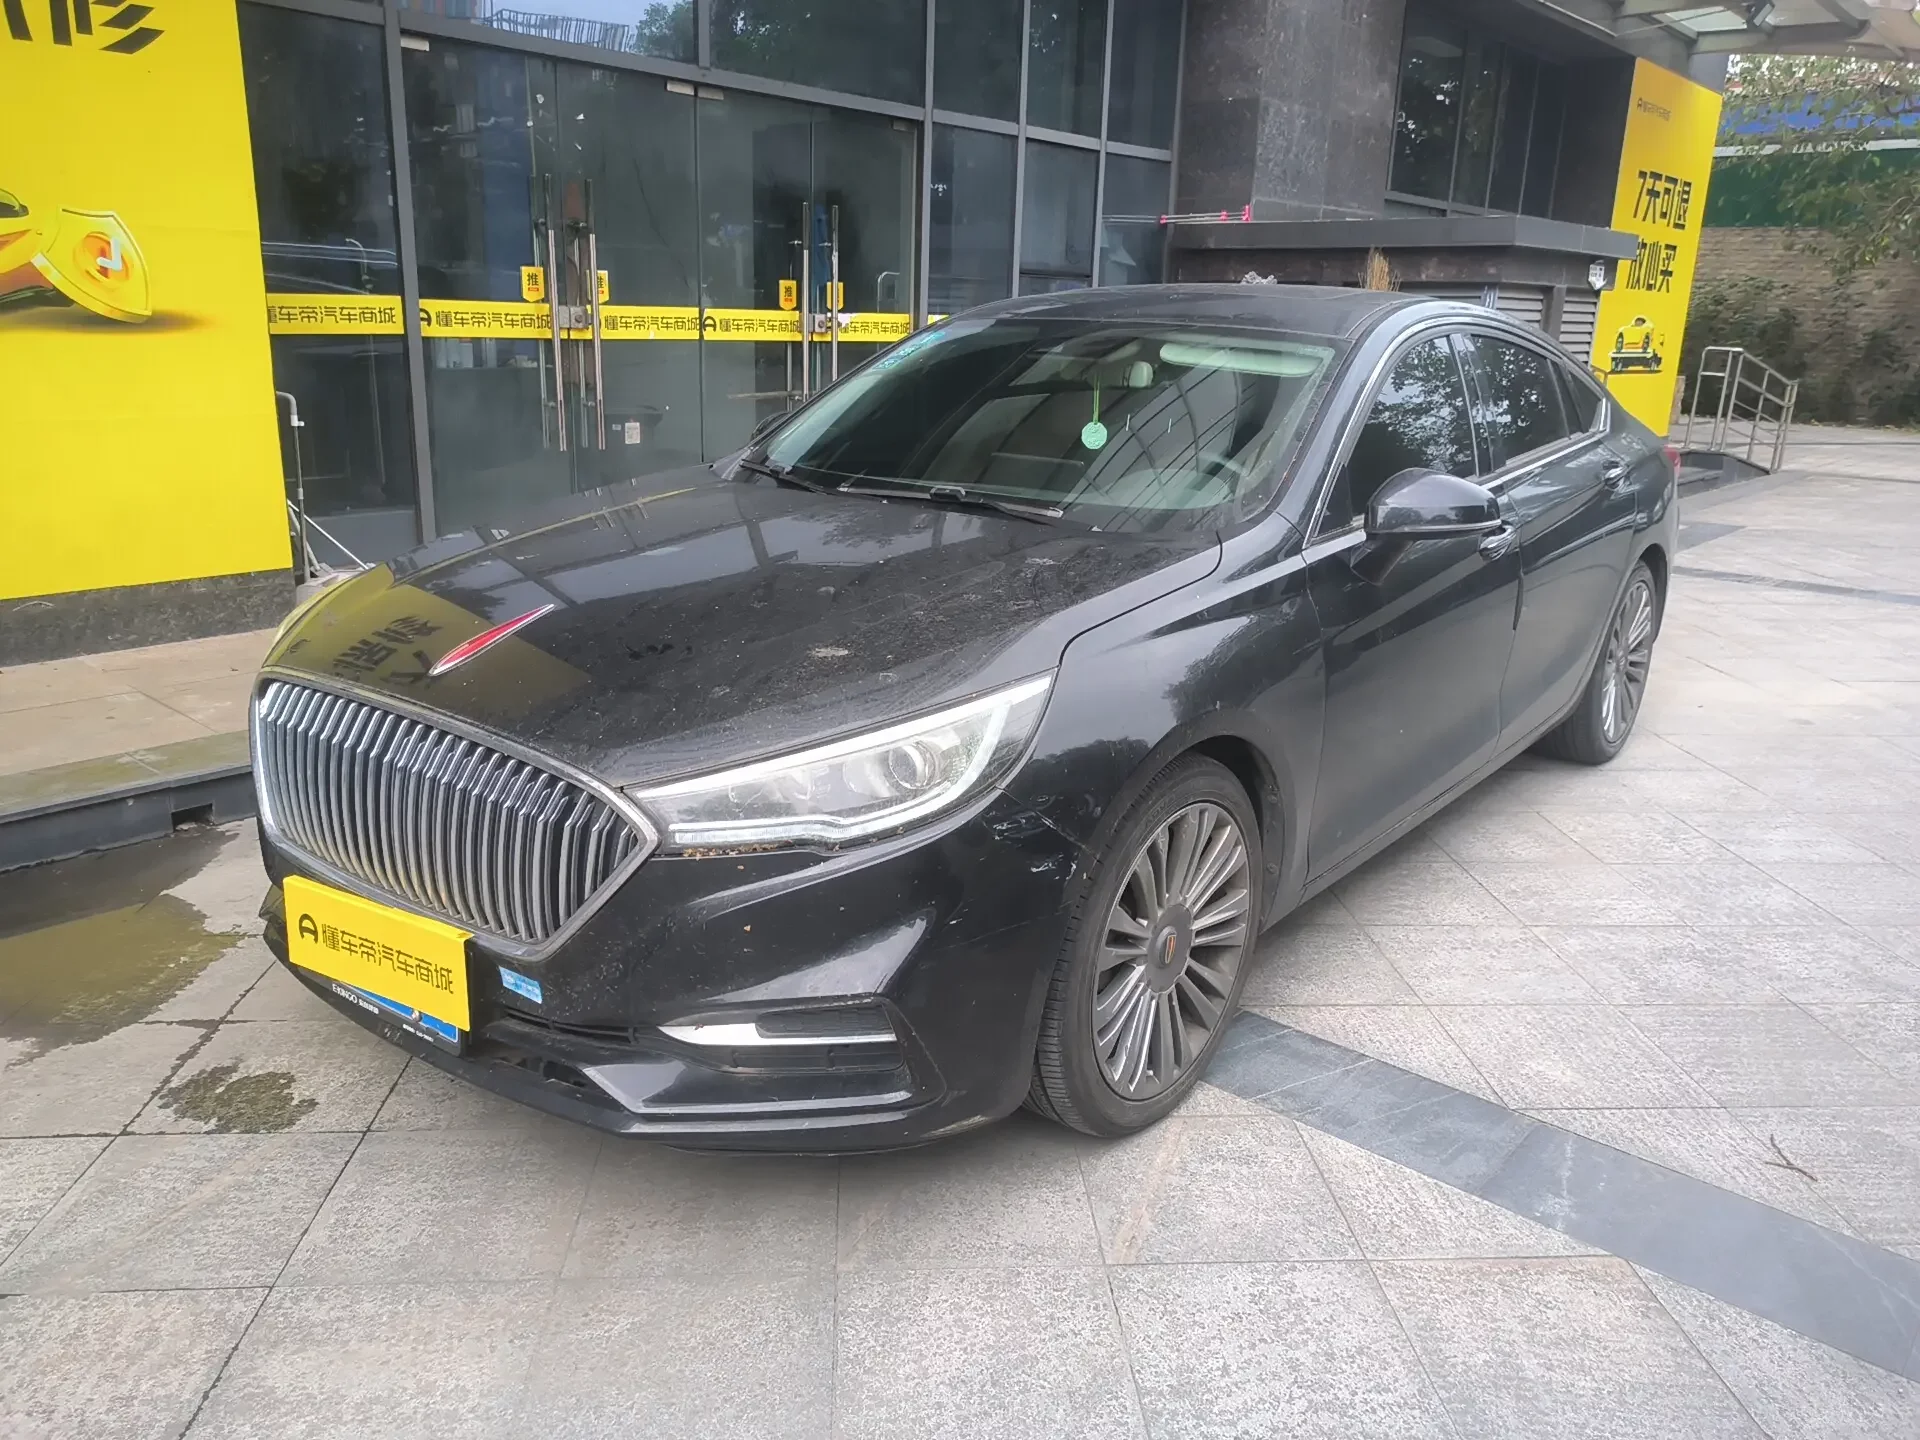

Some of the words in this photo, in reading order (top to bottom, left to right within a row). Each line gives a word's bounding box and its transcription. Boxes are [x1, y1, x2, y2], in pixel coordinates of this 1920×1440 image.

[1633, 169, 1692, 231] 7天可退
[526, 272, 539, 287] 推
[321, 923, 454, 994] 懂车帝汽车商城
